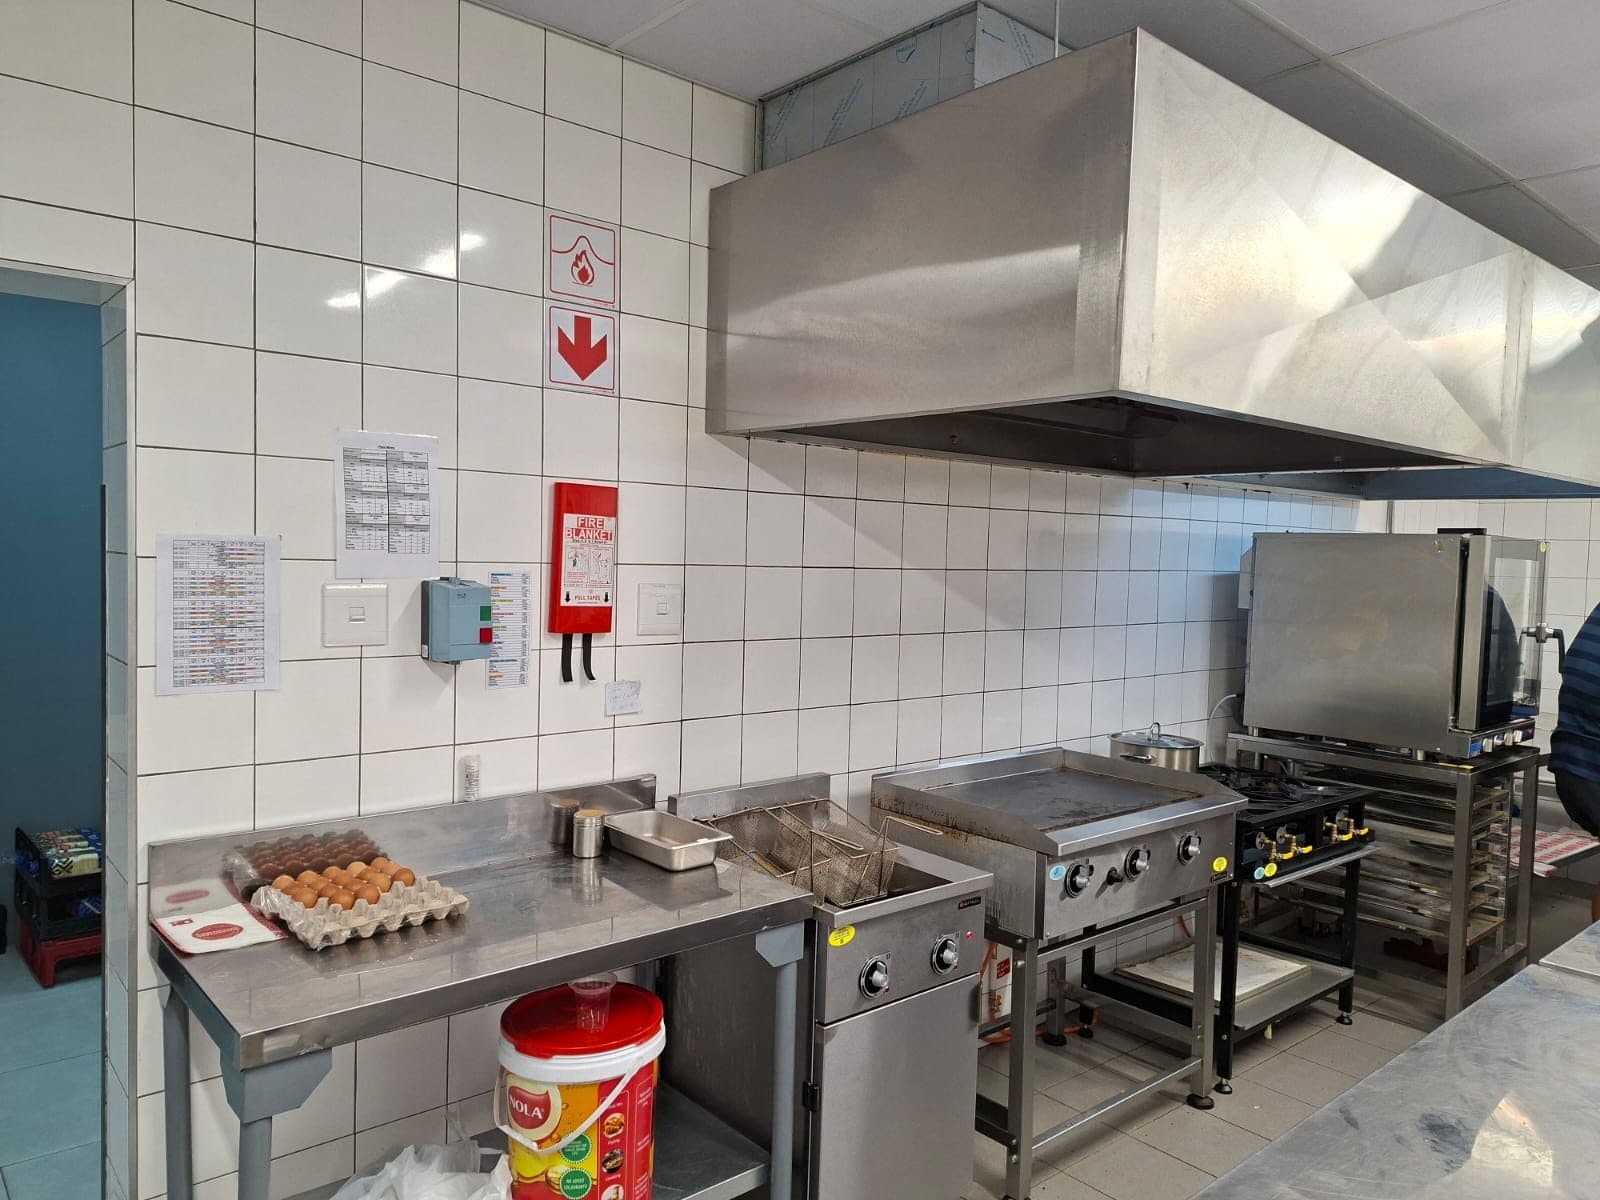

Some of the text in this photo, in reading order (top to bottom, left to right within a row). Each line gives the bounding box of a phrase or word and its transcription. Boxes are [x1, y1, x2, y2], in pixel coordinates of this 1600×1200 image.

[578, 517, 605, 529] FIRE
[566, 529, 613, 541] BLANKET
[509, 1094, 543, 1120] NOLA
